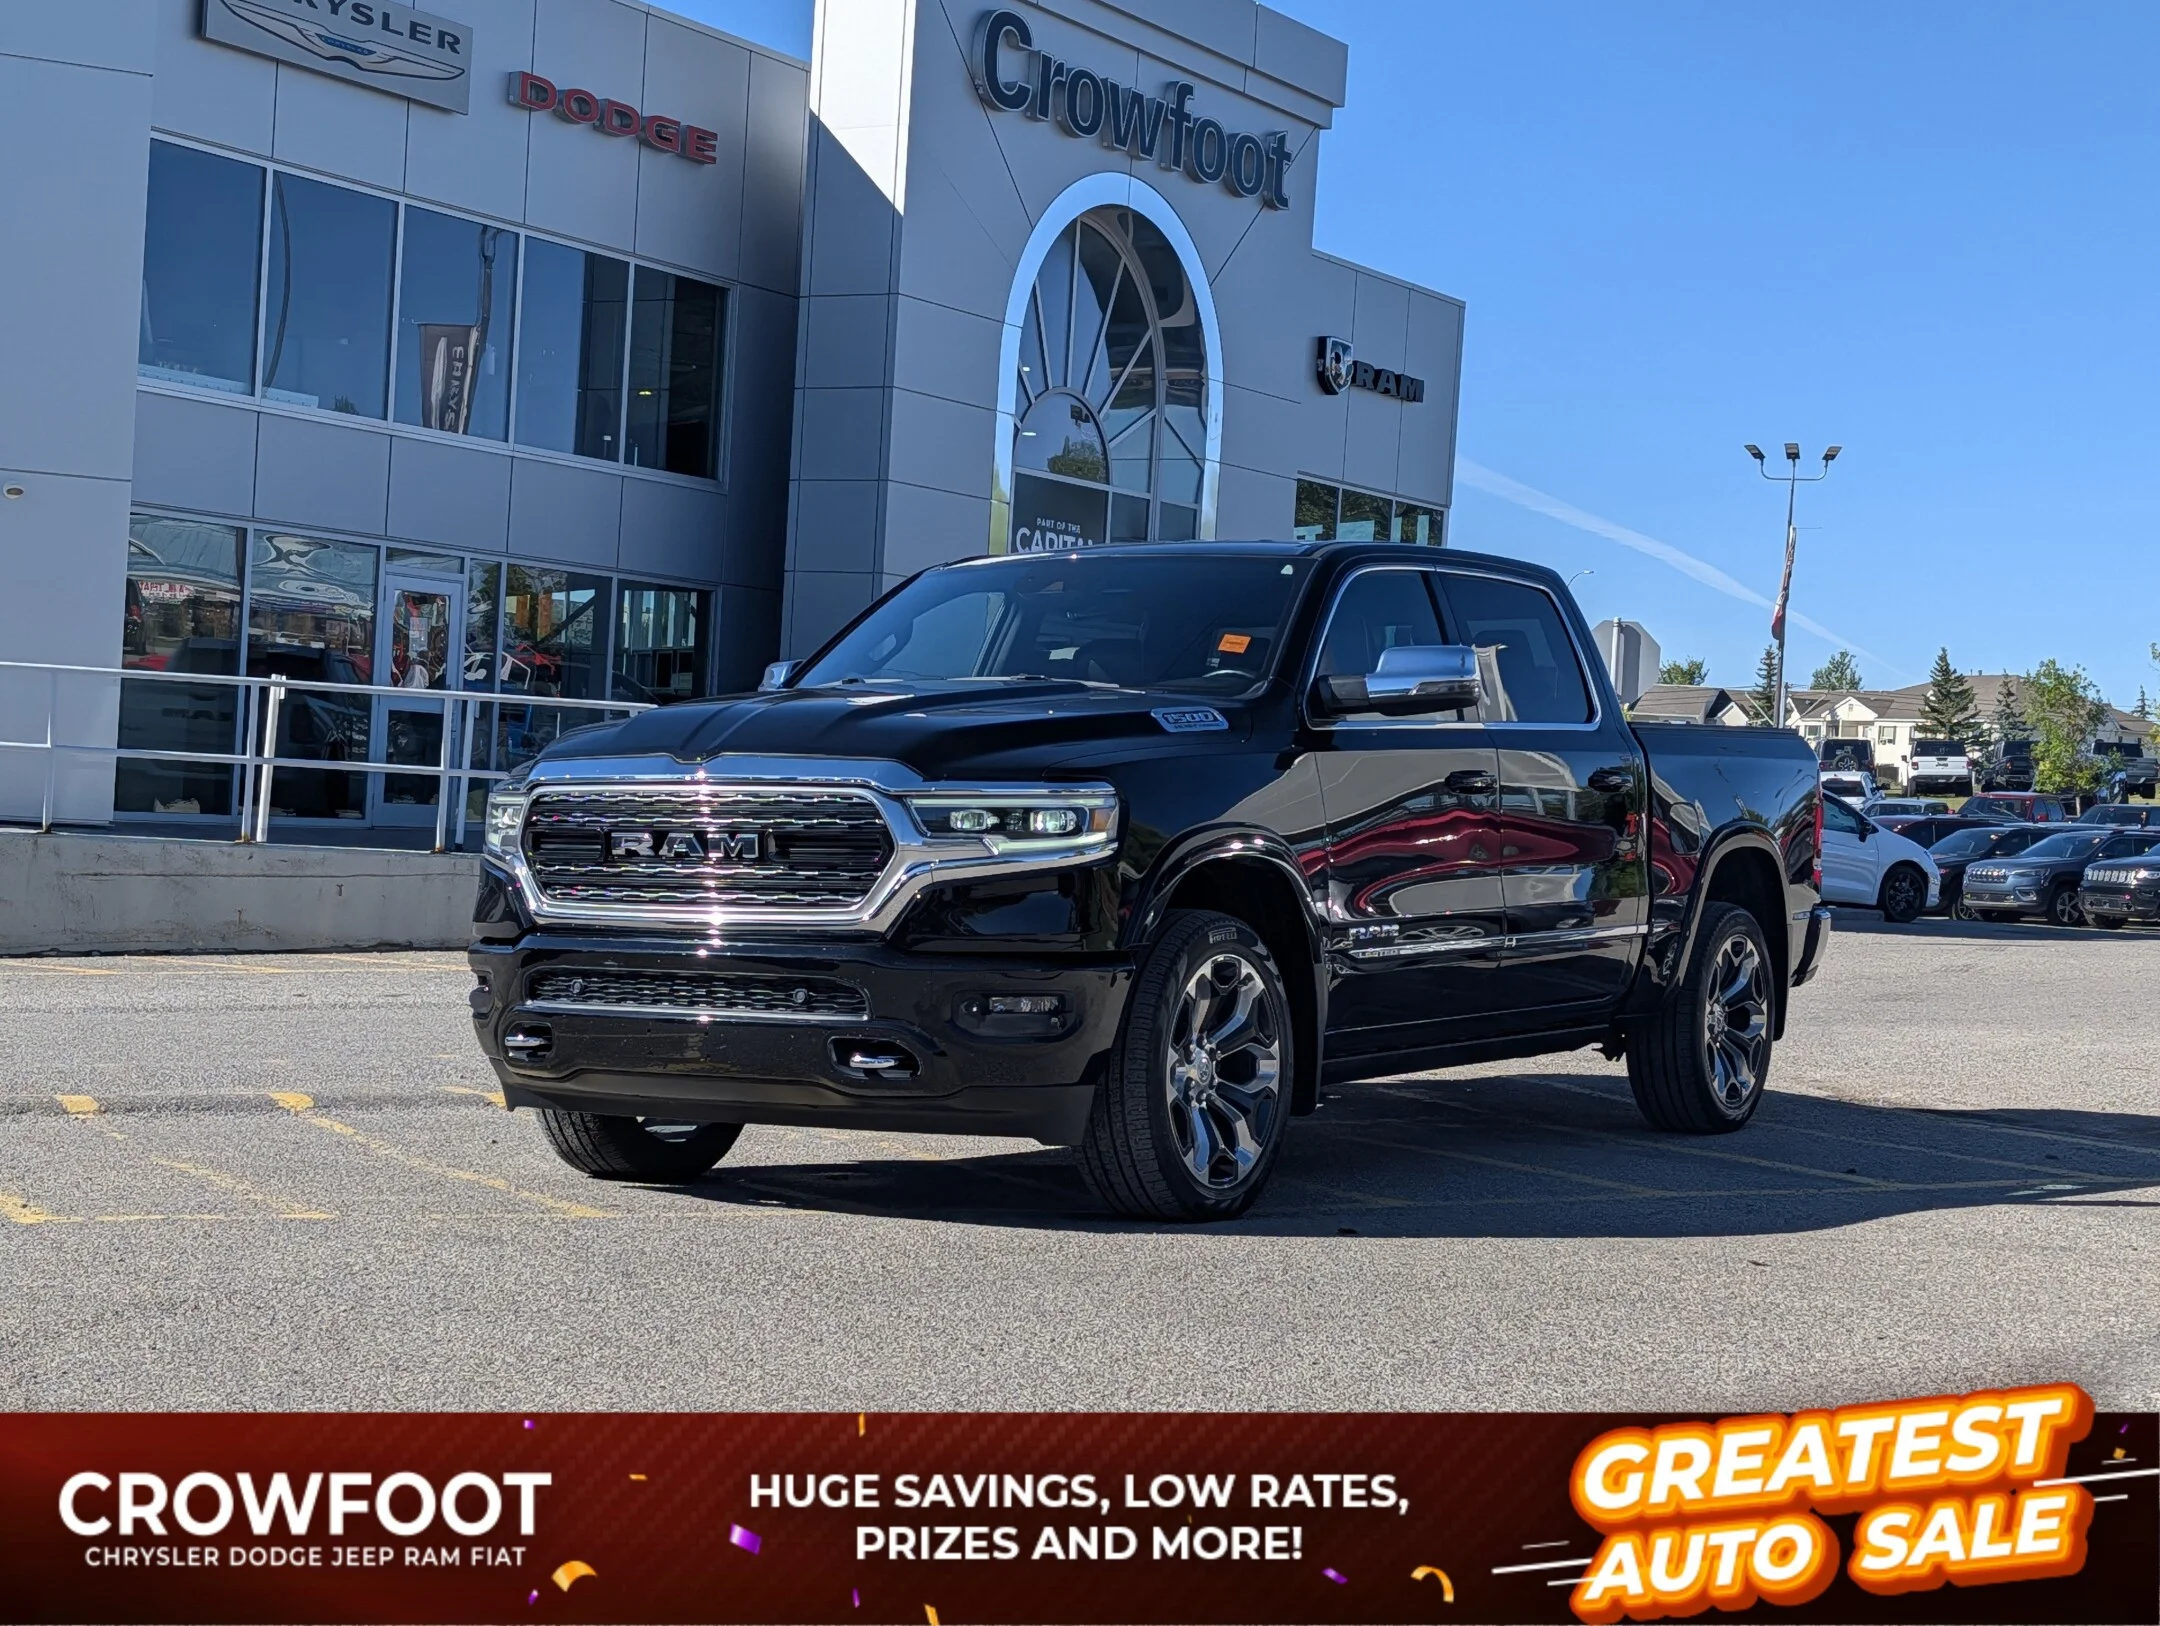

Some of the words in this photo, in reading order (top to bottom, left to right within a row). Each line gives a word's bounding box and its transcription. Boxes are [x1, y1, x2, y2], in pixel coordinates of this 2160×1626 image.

[506, 71, 718, 165] DODGE
[976, 8, 1293, 210] Crowfoot
[1352, 360, 1425, 403] RAM
[1036, 517, 1055, 528] PART
[1056, 521, 1066, 531] OF
[1164, 712, 1215, 723] 1500
[611, 832, 759, 859] RAM
